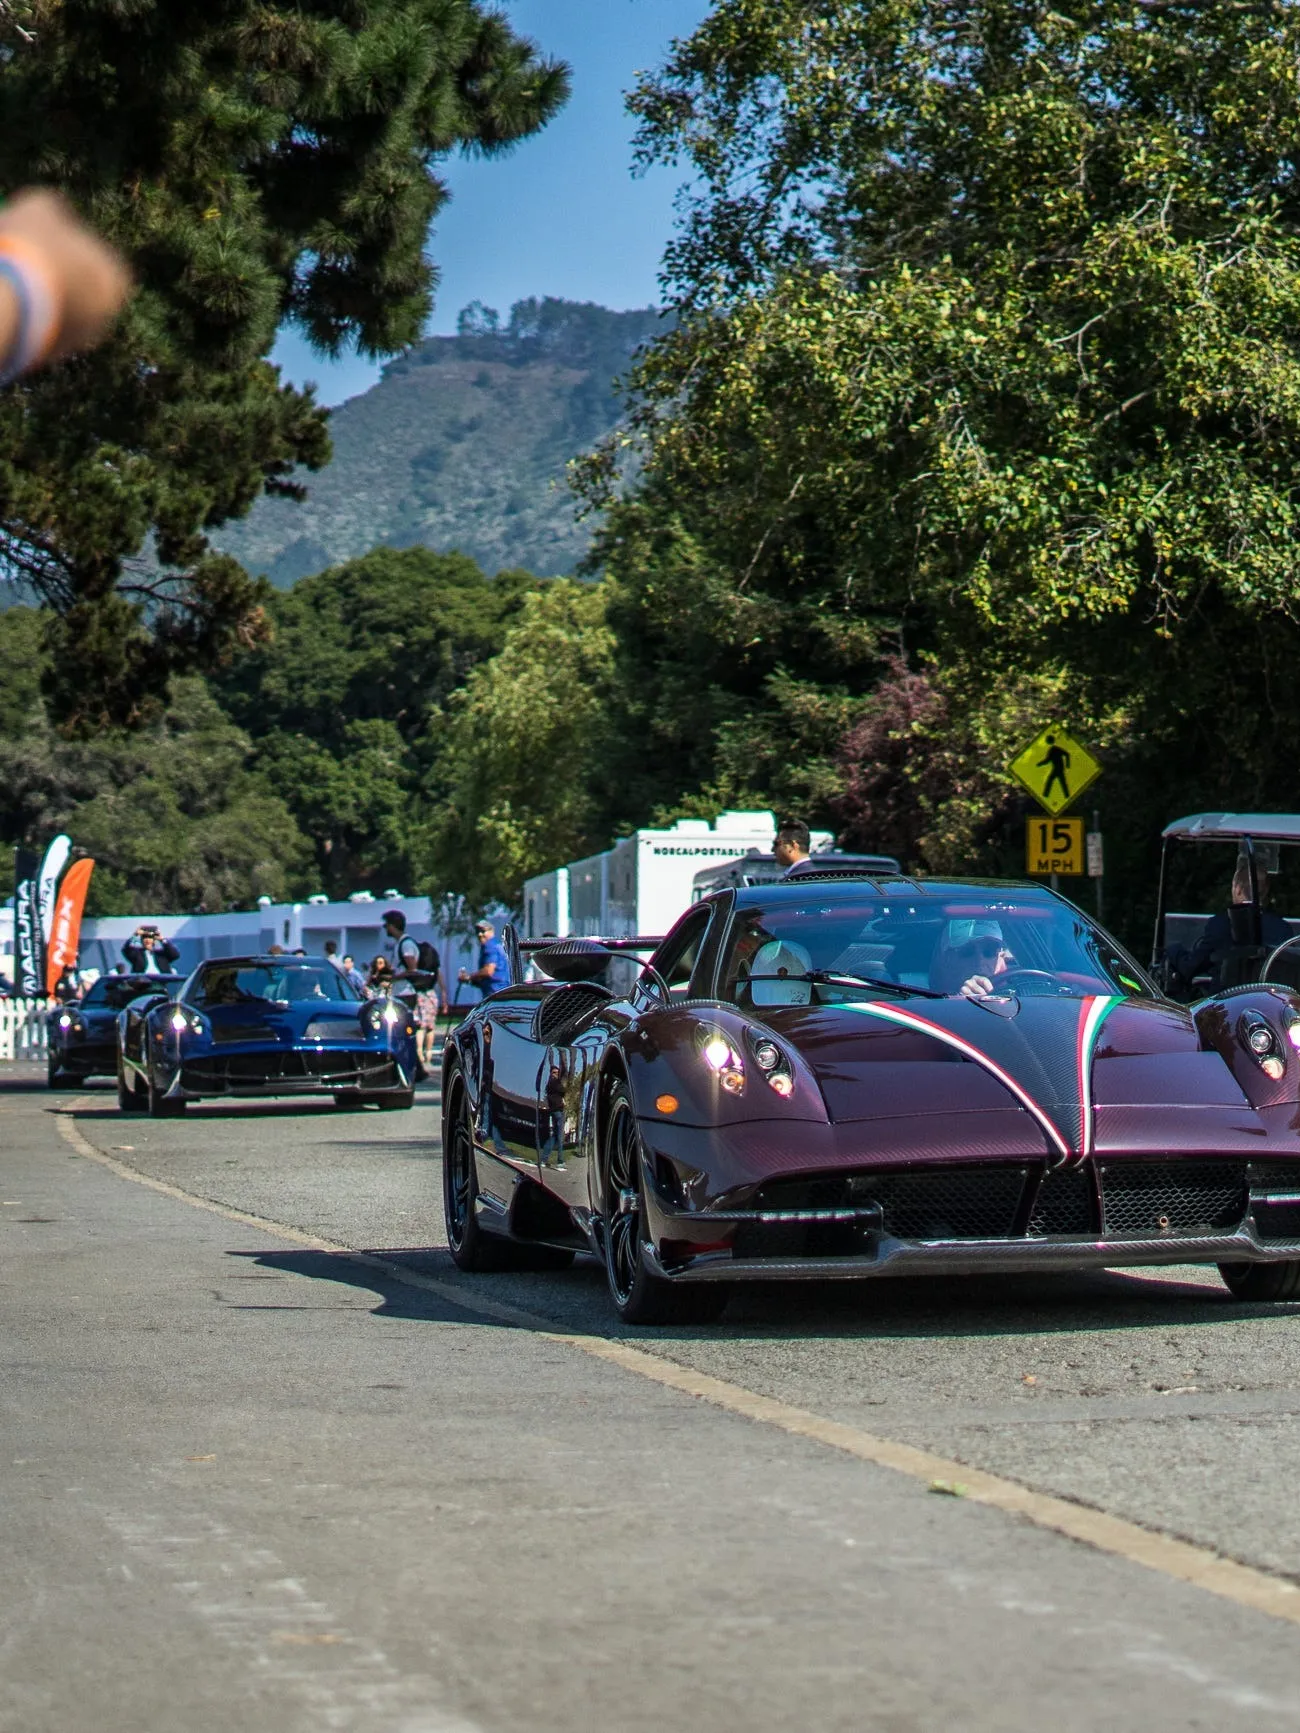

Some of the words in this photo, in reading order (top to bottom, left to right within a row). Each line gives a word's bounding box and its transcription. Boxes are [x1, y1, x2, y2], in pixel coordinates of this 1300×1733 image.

[1038, 824, 1072, 854] 15
[653, 847, 748, 856] NORCALPORTABLE
[1037, 859, 1074, 872] MPH
[17, 880, 36, 975] ACURA
